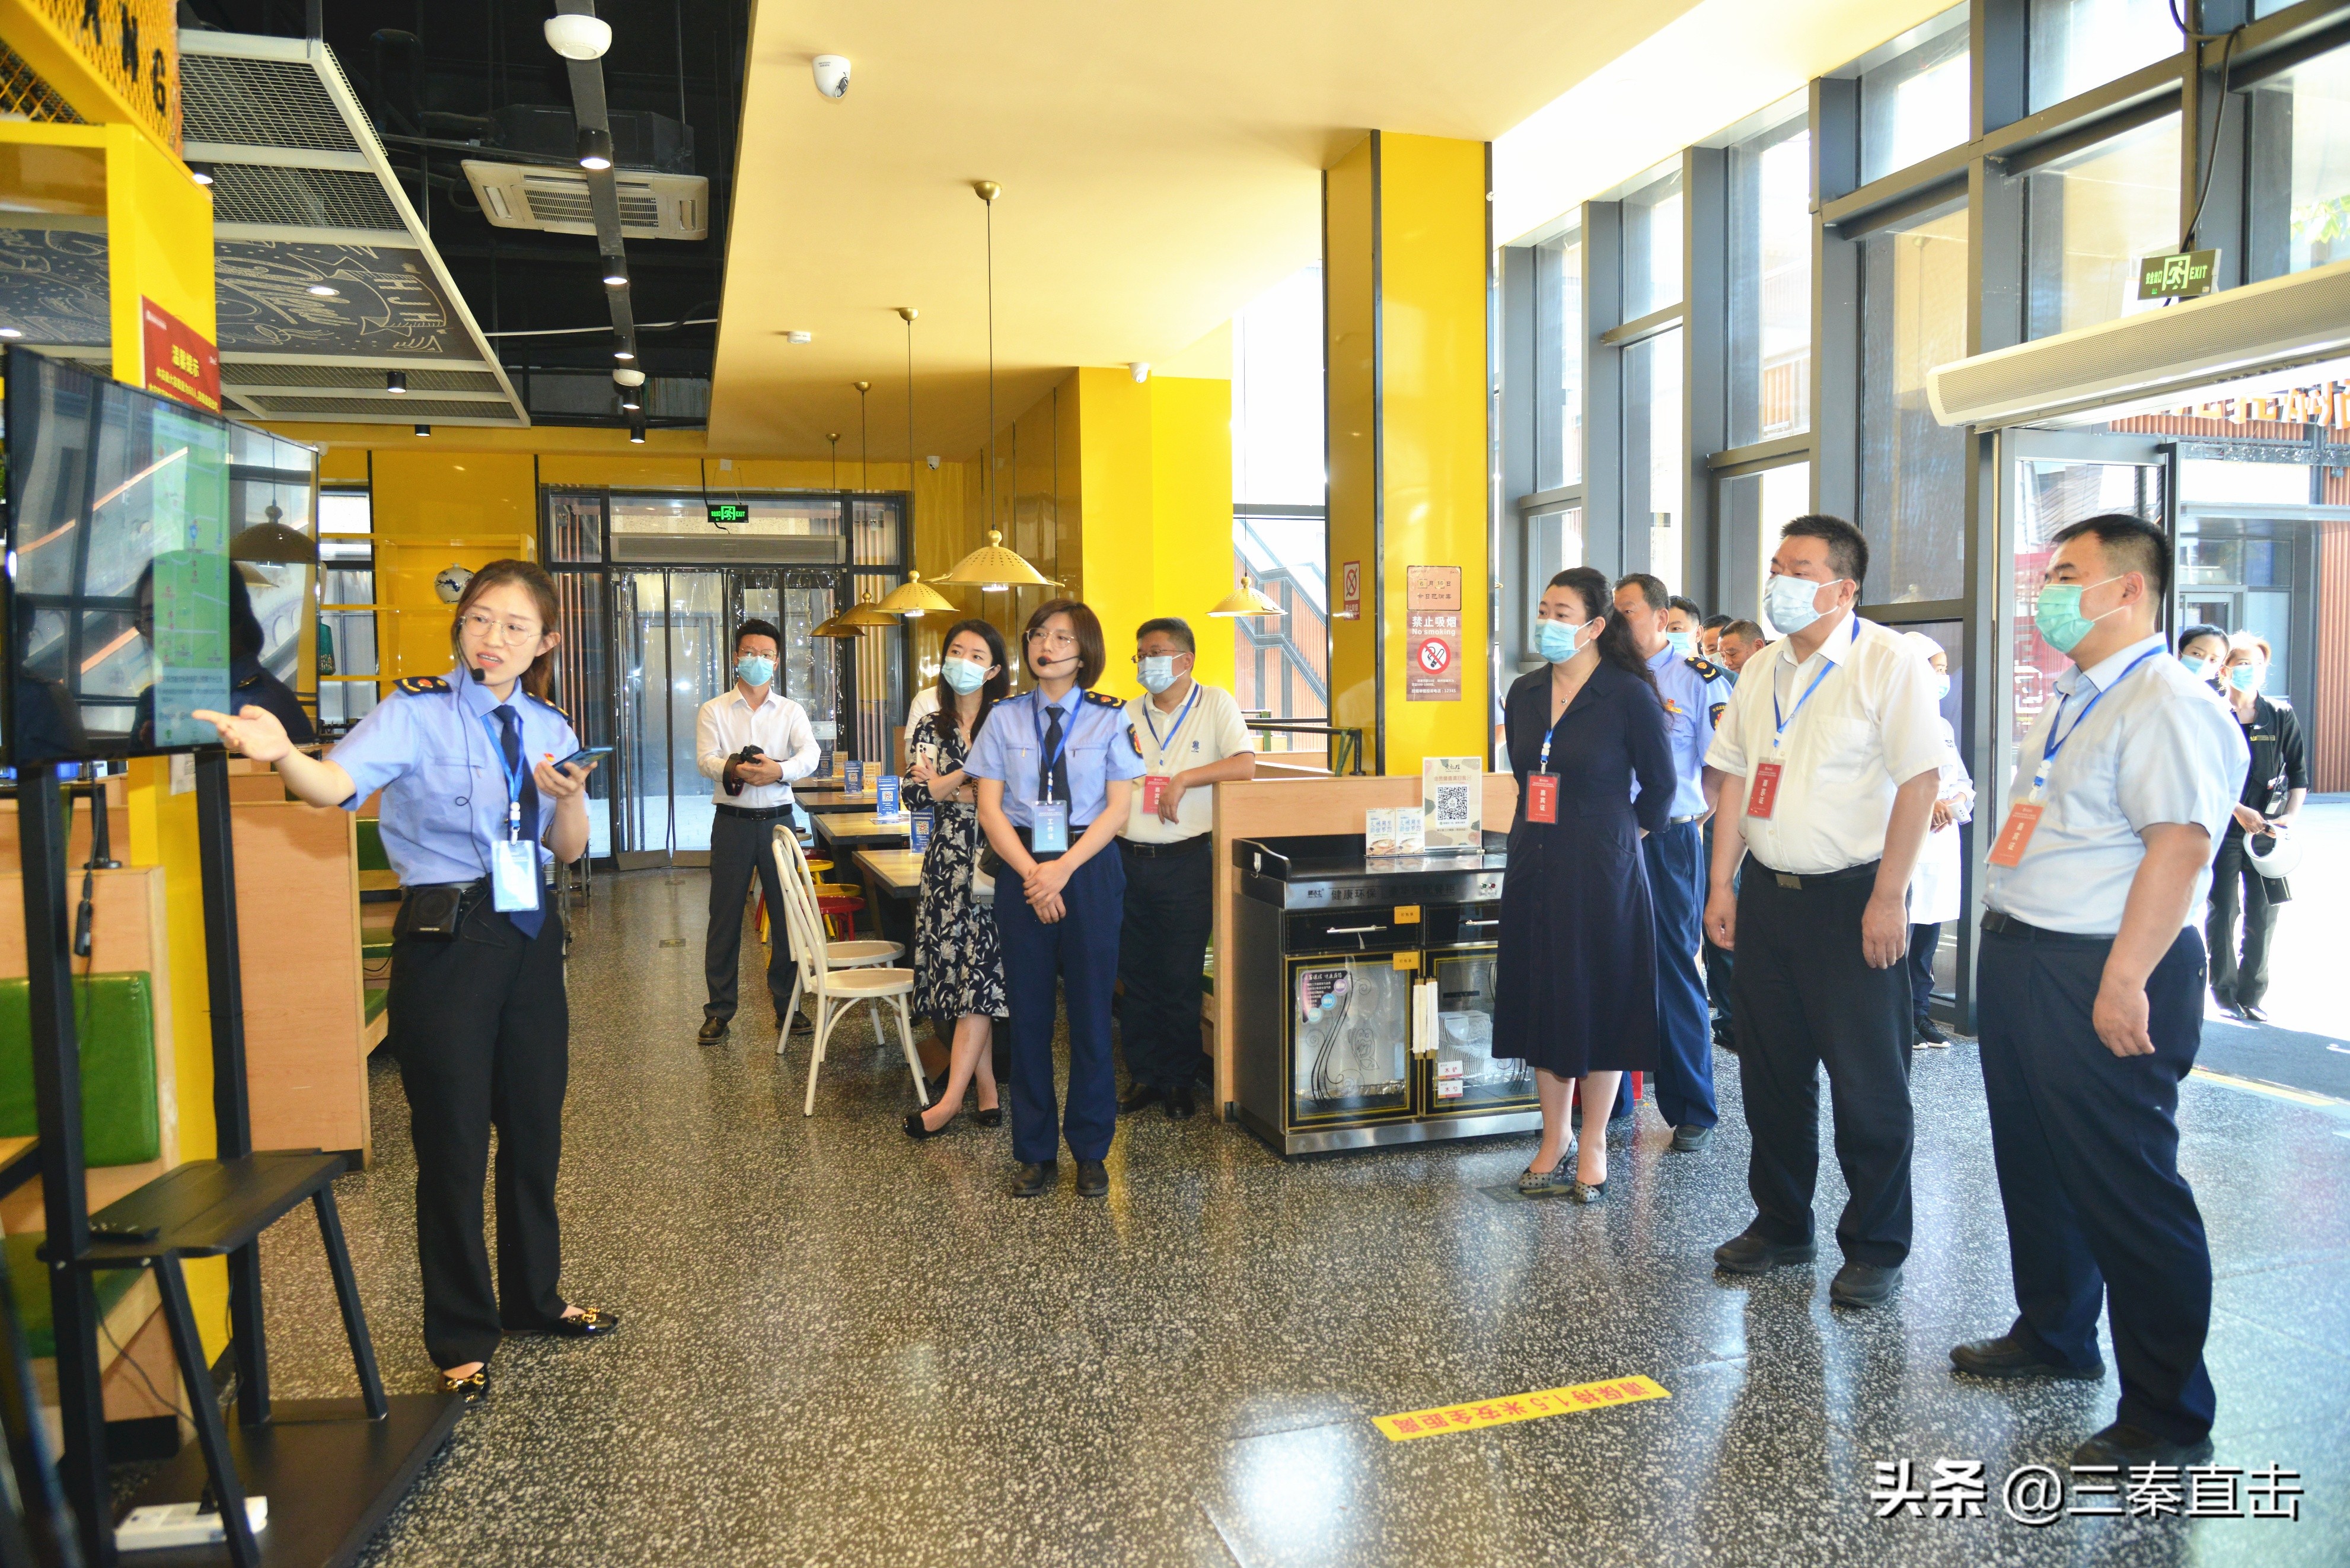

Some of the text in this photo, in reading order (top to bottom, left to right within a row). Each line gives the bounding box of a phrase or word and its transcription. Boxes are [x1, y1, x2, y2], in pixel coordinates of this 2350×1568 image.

[2189, 265, 2208, 280] EXIT
[1412, 616, 1457, 627] 禁止吸烟
[1424, 628, 1456, 636] smoking
[1331, 888, 1378, 901] 健康环保
